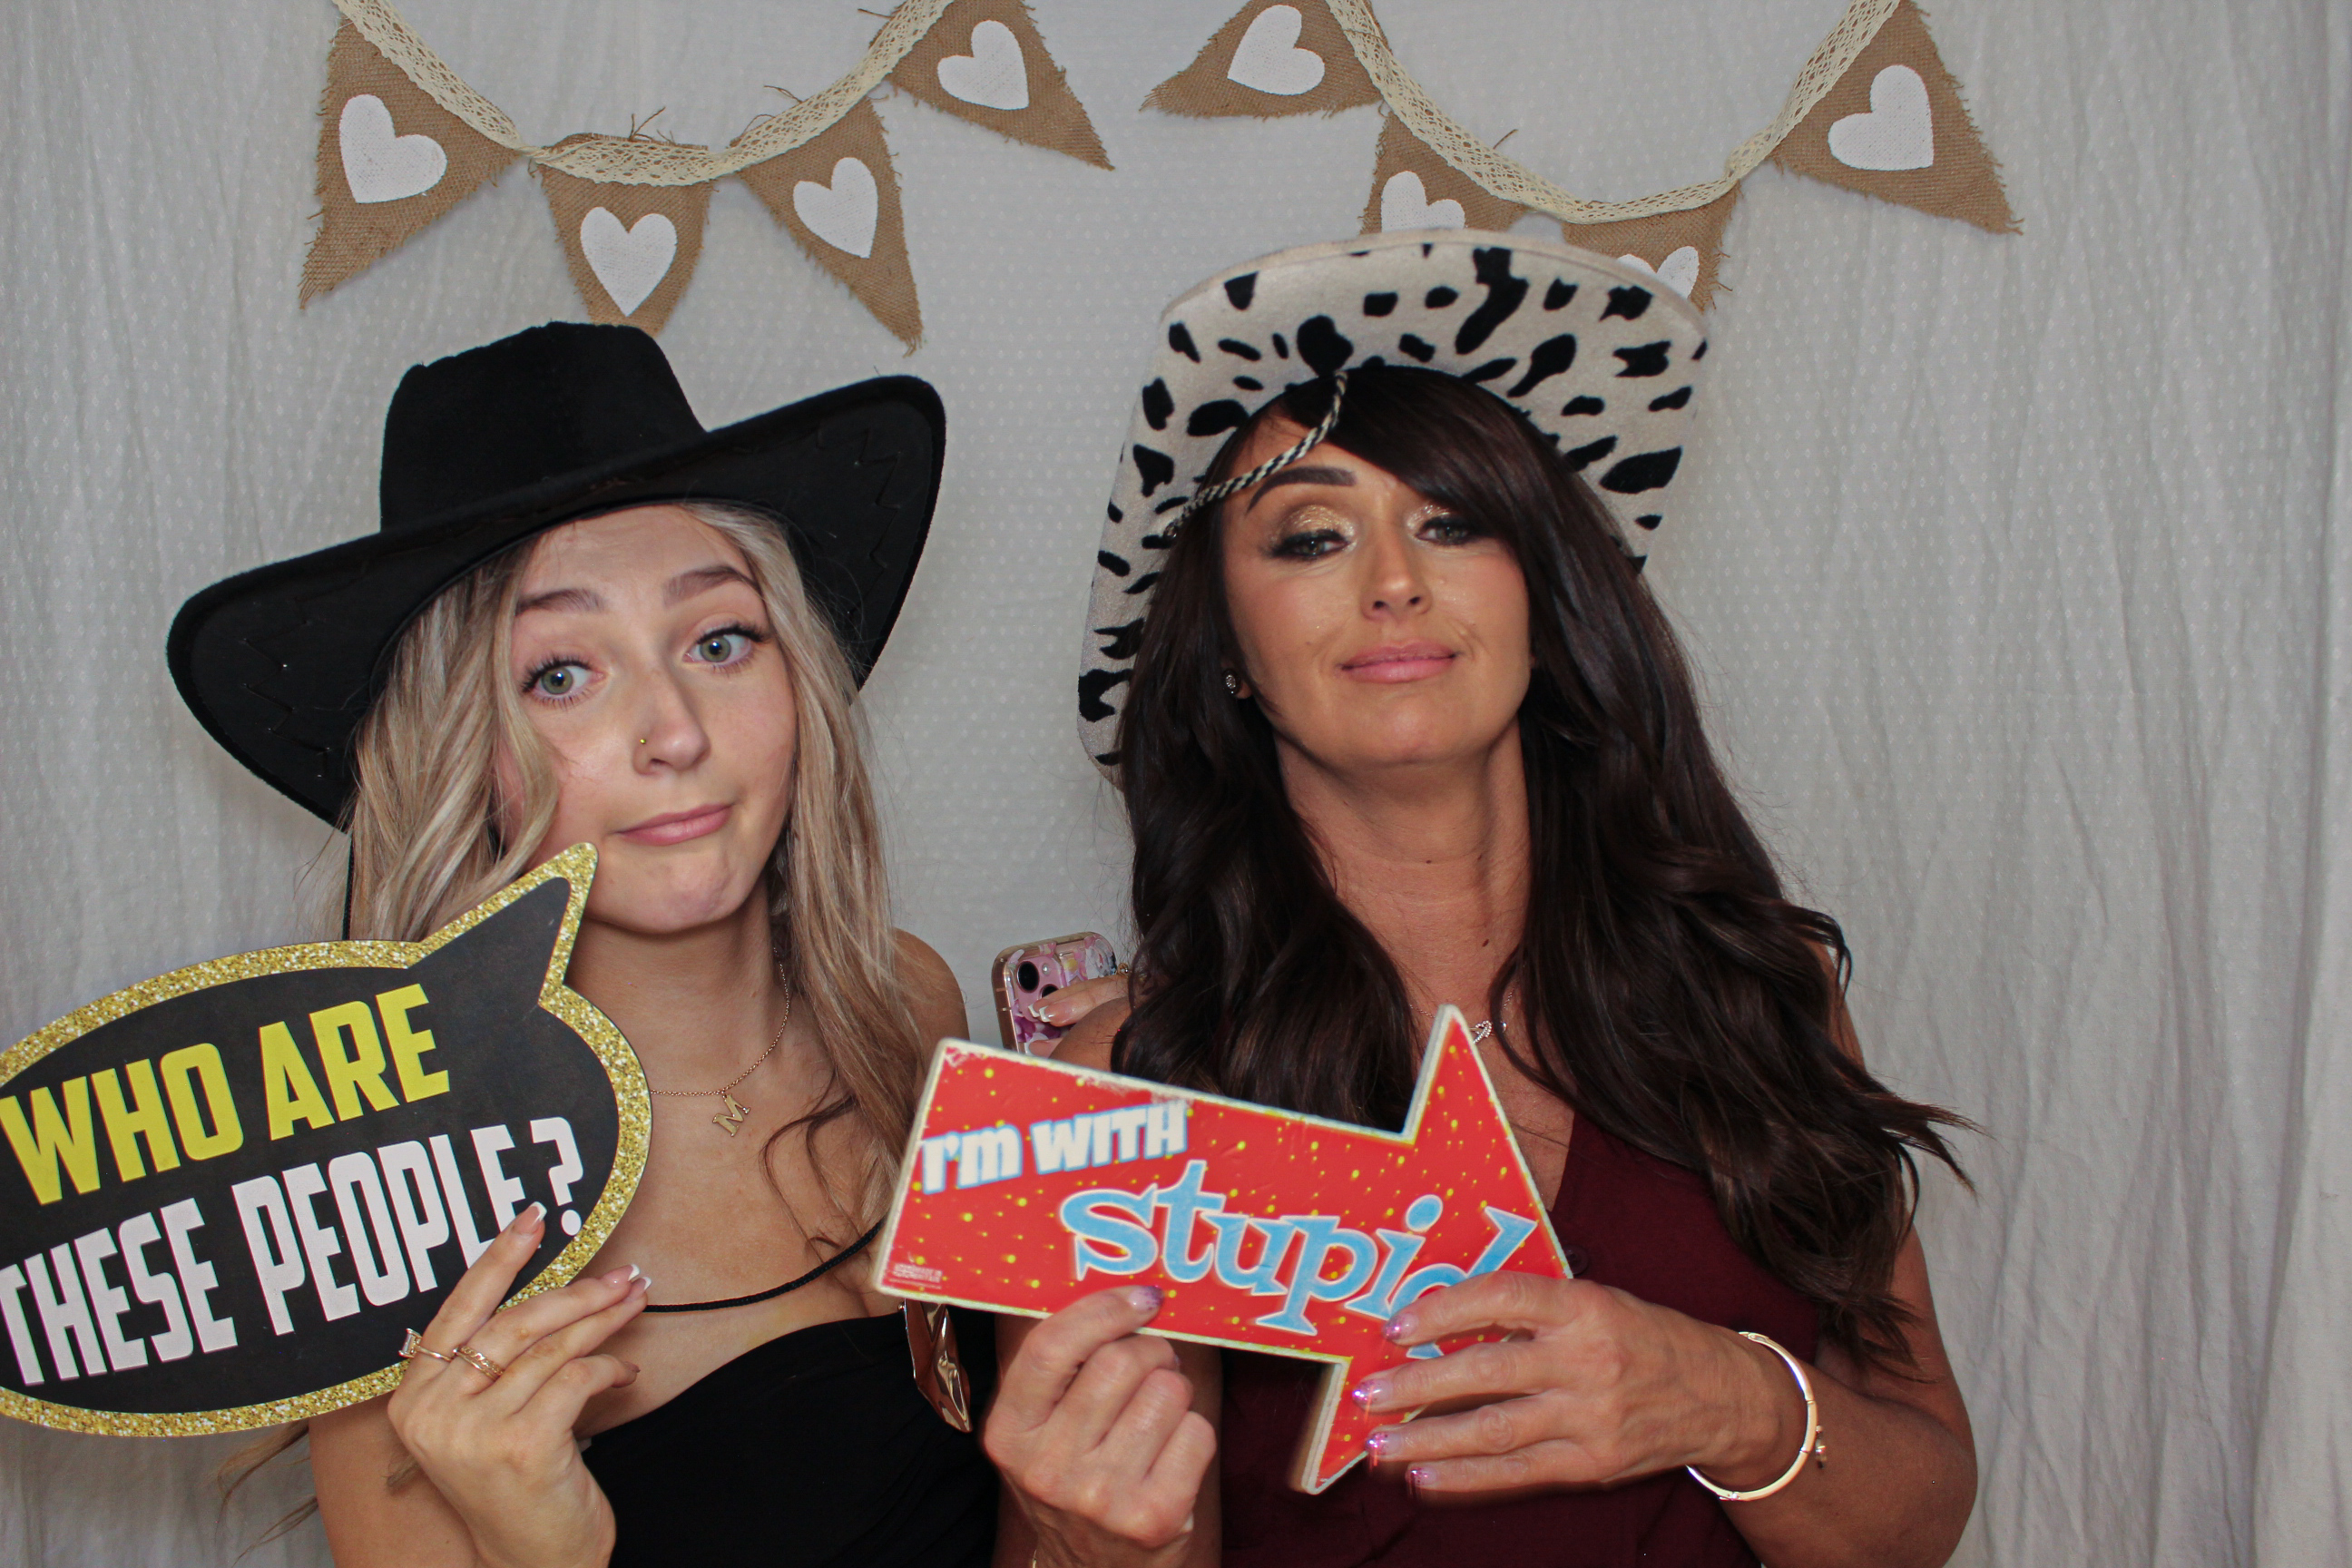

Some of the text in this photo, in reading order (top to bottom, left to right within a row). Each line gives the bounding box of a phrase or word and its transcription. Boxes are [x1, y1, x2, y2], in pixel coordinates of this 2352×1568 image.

[0, 984, 450, 1206] WHO ARE
[1030, 1100, 1191, 1174] WITH
[0, 1116, 584, 1387] THESE PEOPLE?
